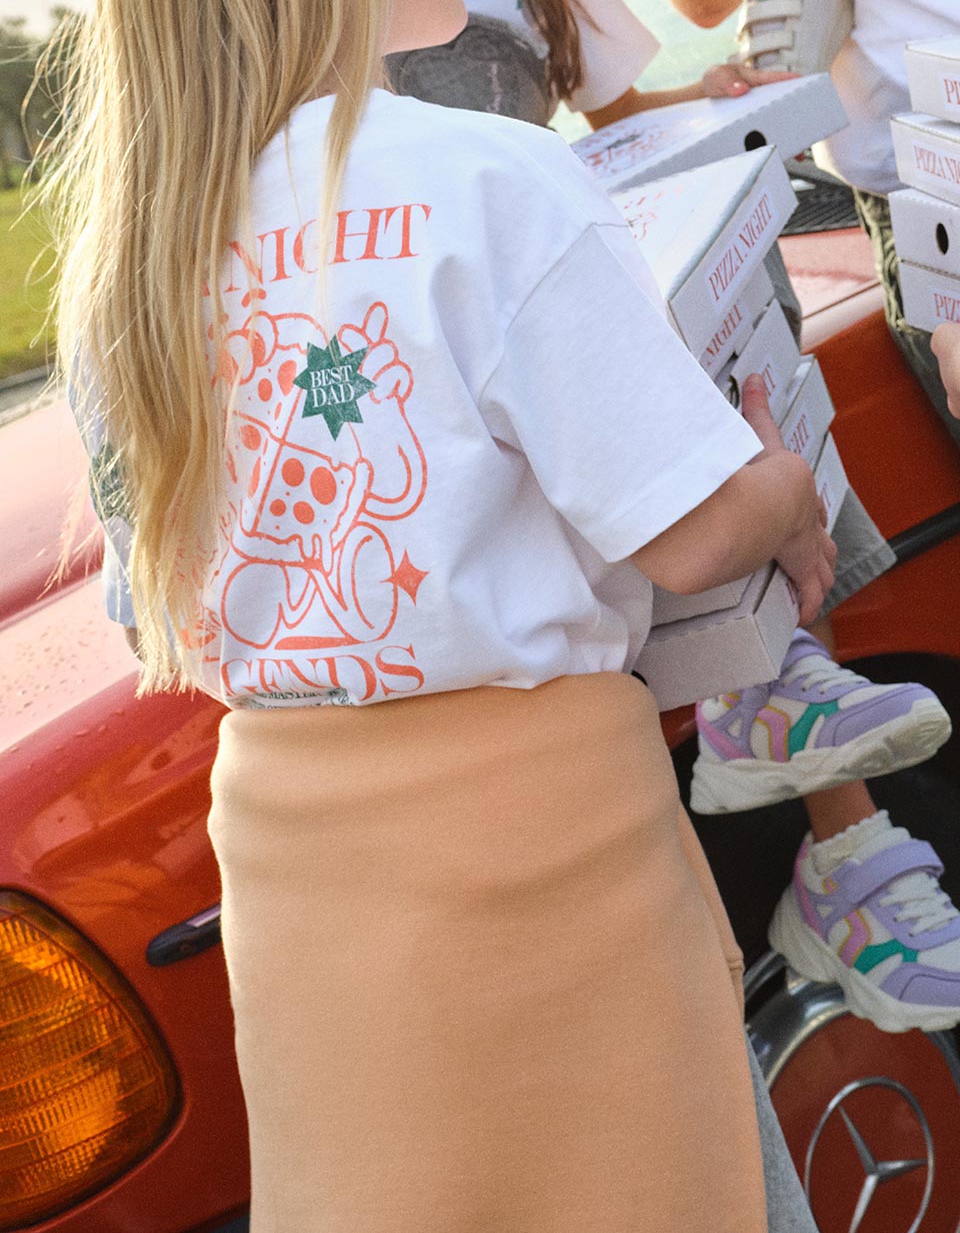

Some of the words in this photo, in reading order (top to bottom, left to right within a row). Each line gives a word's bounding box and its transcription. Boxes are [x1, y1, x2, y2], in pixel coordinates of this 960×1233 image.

[914, 145, 946, 179] PIZZA
[708, 243, 744, 302] PIZZA
[738, 193, 772, 259] NIGHT
[310, 364, 353, 389] BEST
[311, 382, 355, 408] DAD
